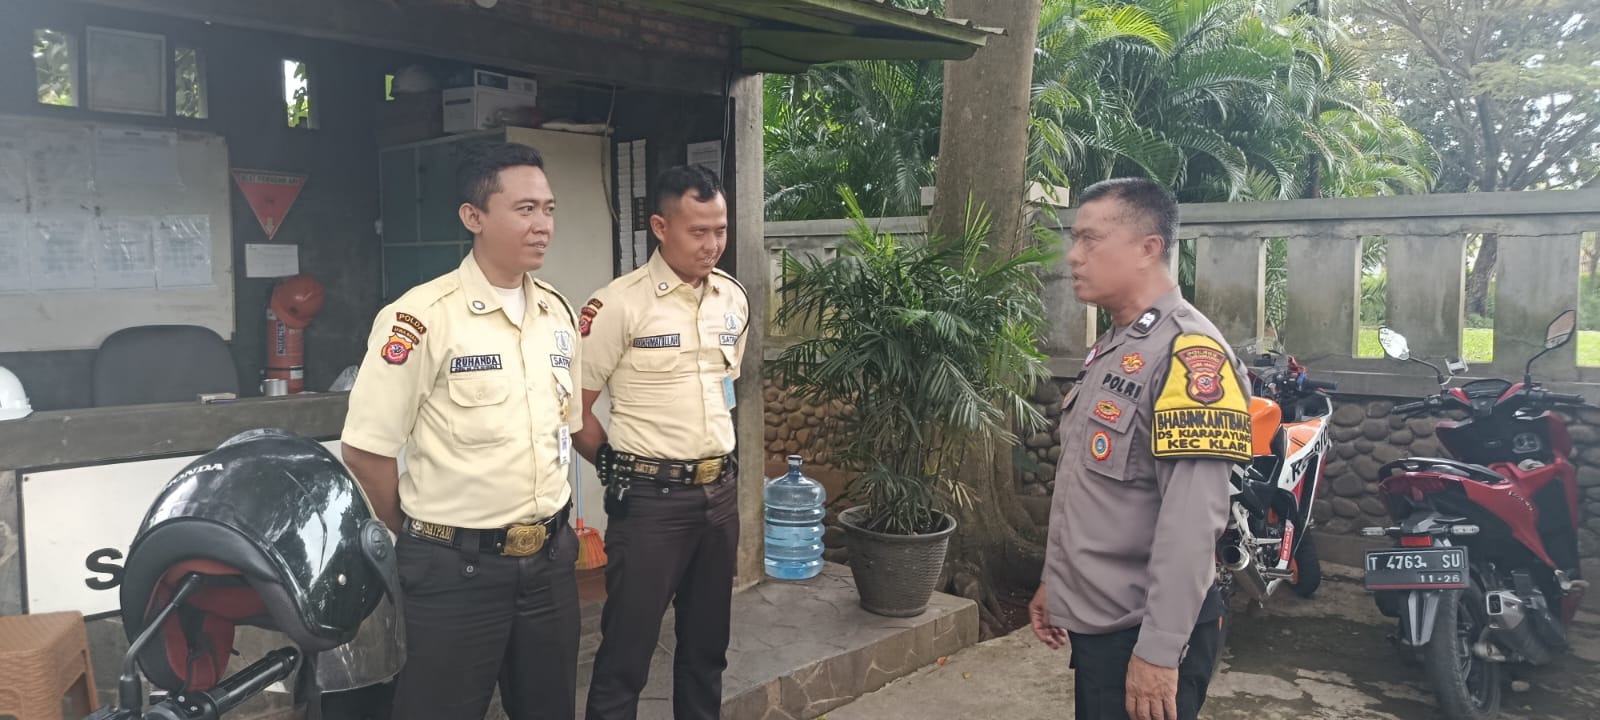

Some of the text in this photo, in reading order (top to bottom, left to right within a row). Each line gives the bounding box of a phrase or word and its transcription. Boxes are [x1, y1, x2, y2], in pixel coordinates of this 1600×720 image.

[399, 313, 424, 333] POLDA
[455, 356, 498, 368] RUHANDA
[1103, 373, 1142, 399] POLRI
[1157, 431, 1173, 439] DS
[1168, 439, 1247, 452] KEC KLARI
[1369, 553, 1460, 571] T 4763 SU
